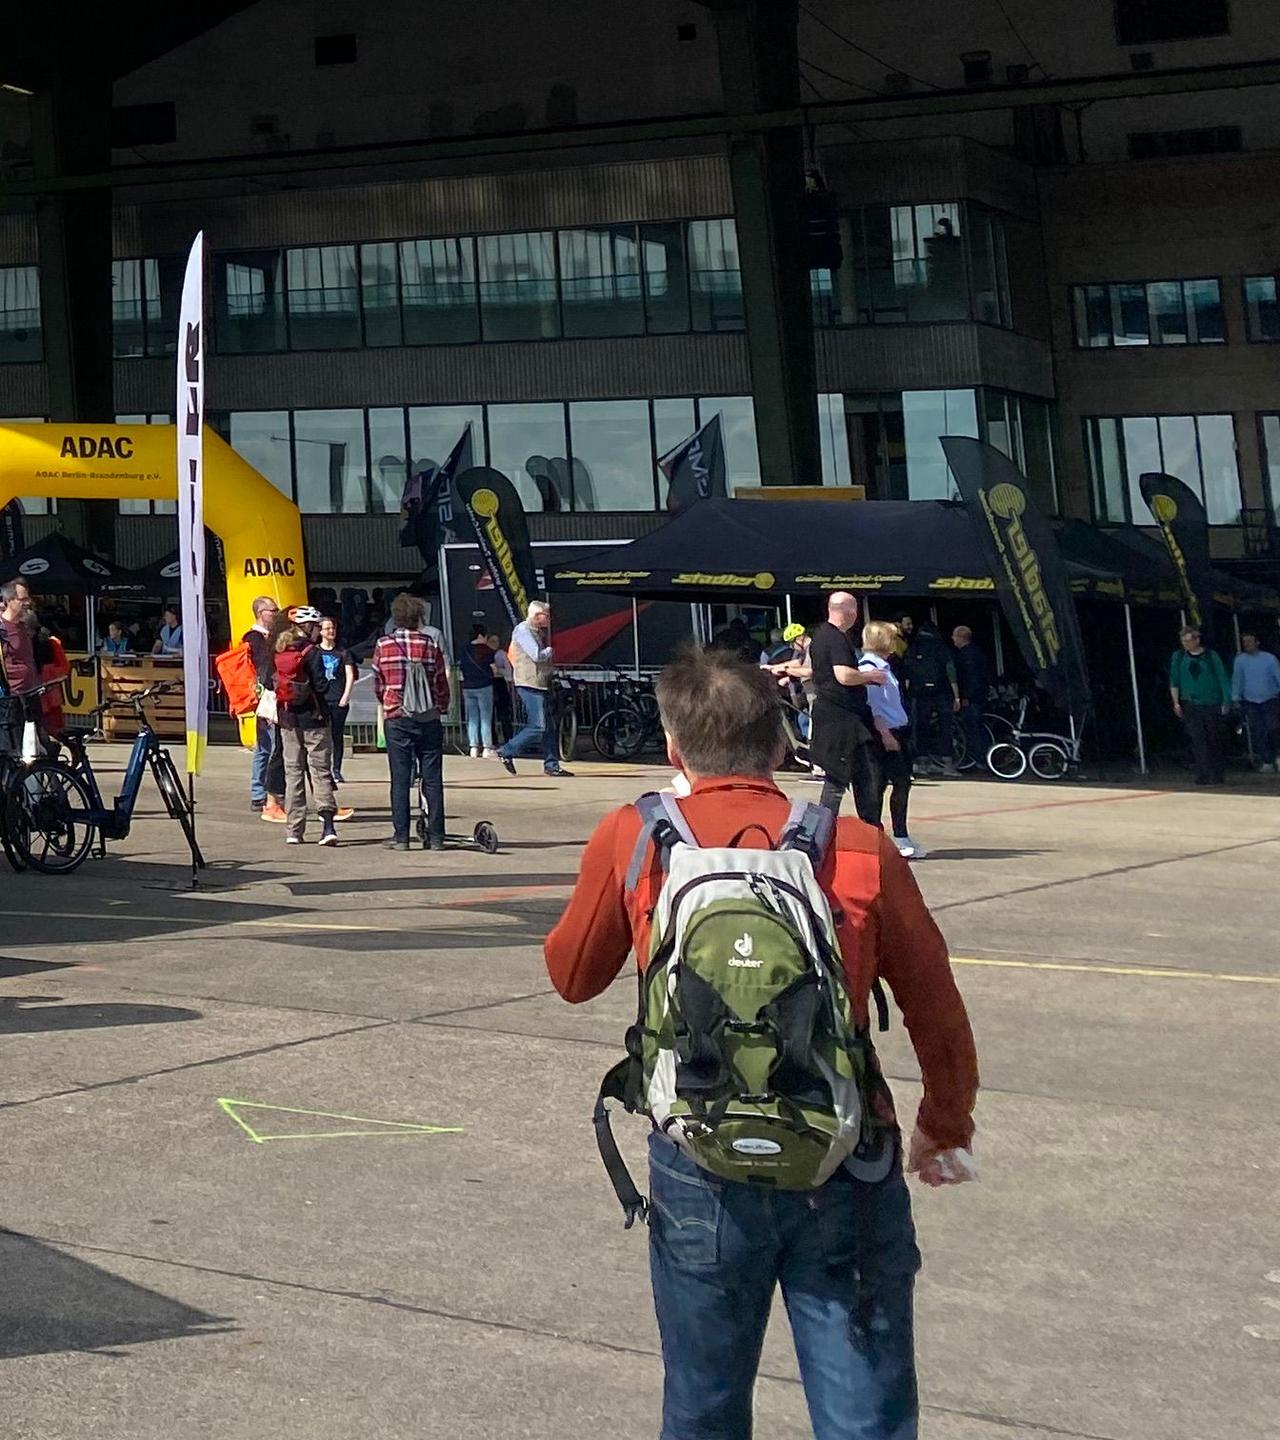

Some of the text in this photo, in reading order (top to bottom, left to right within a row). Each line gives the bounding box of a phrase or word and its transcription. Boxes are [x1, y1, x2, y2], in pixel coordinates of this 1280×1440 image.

[60, 436, 133, 459] ADAC
[35, 470, 59, 478] ADAC
[243, 557, 295, 578] ADAC
[728, 956, 764, 968] deuter
